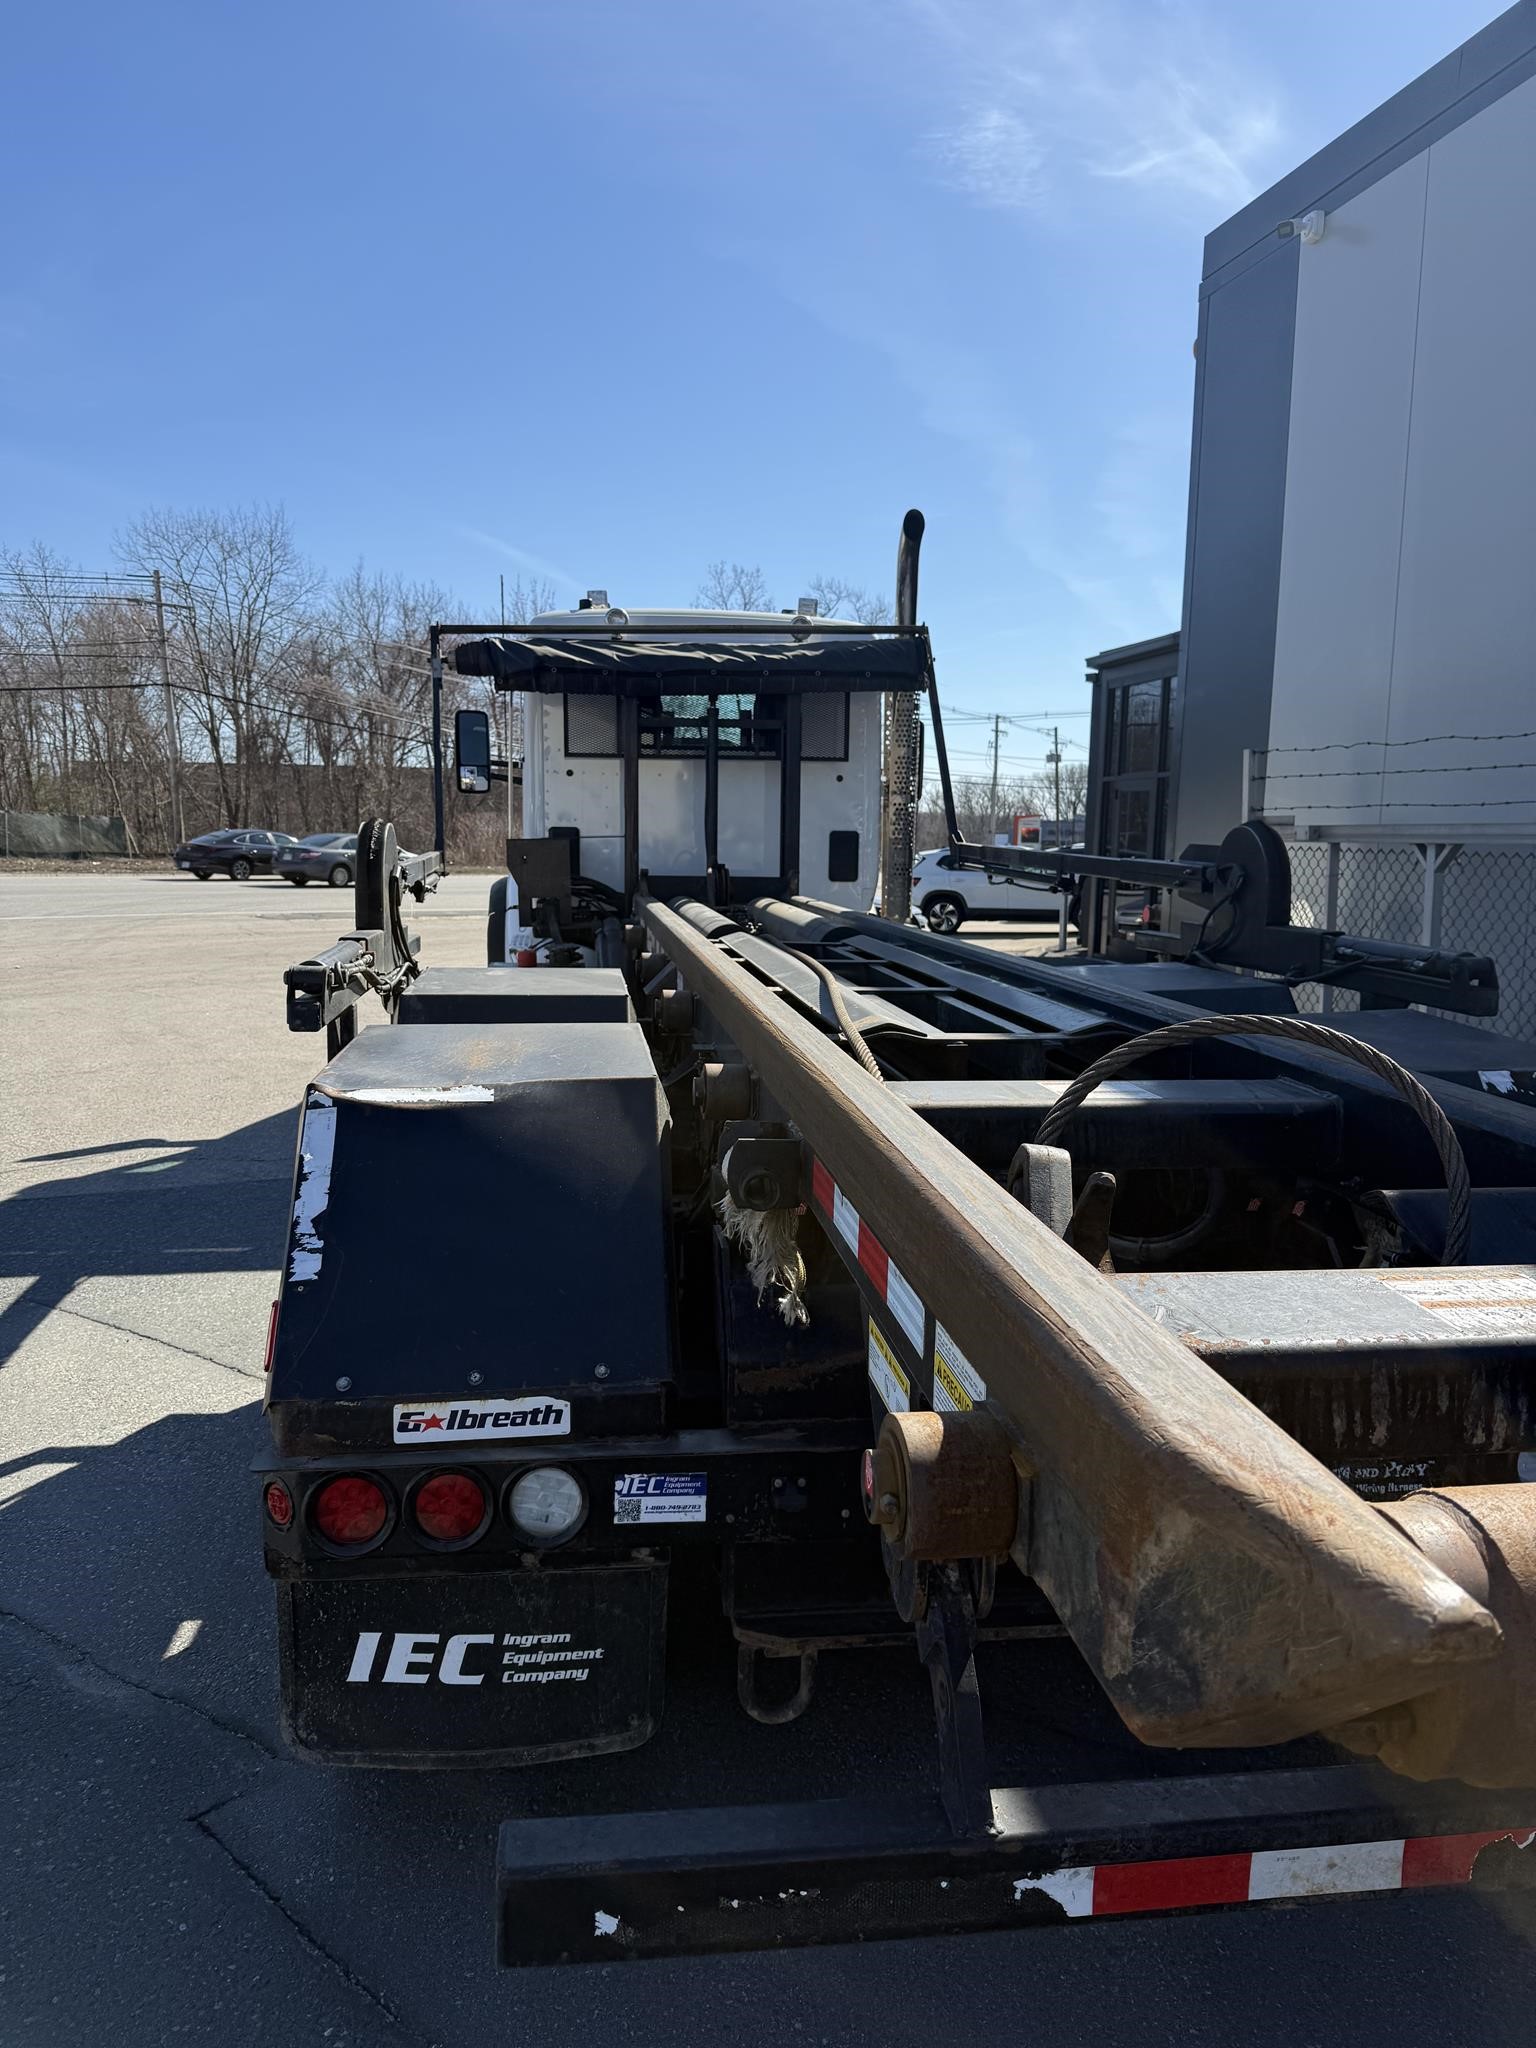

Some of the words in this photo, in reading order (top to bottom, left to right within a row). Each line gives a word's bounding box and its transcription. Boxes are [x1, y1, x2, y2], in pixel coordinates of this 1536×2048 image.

[1354, 1467, 1380, 1478] AND
[621, 1476, 665, 1495] IEC
[664, 1481, 702, 1489] Equipment
[346, 1632, 495, 1685] IEC
[502, 1633, 571, 1647] Ingram
[502, 1648, 605, 1666] Equipment
[502, 1668, 589, 1684] Company
